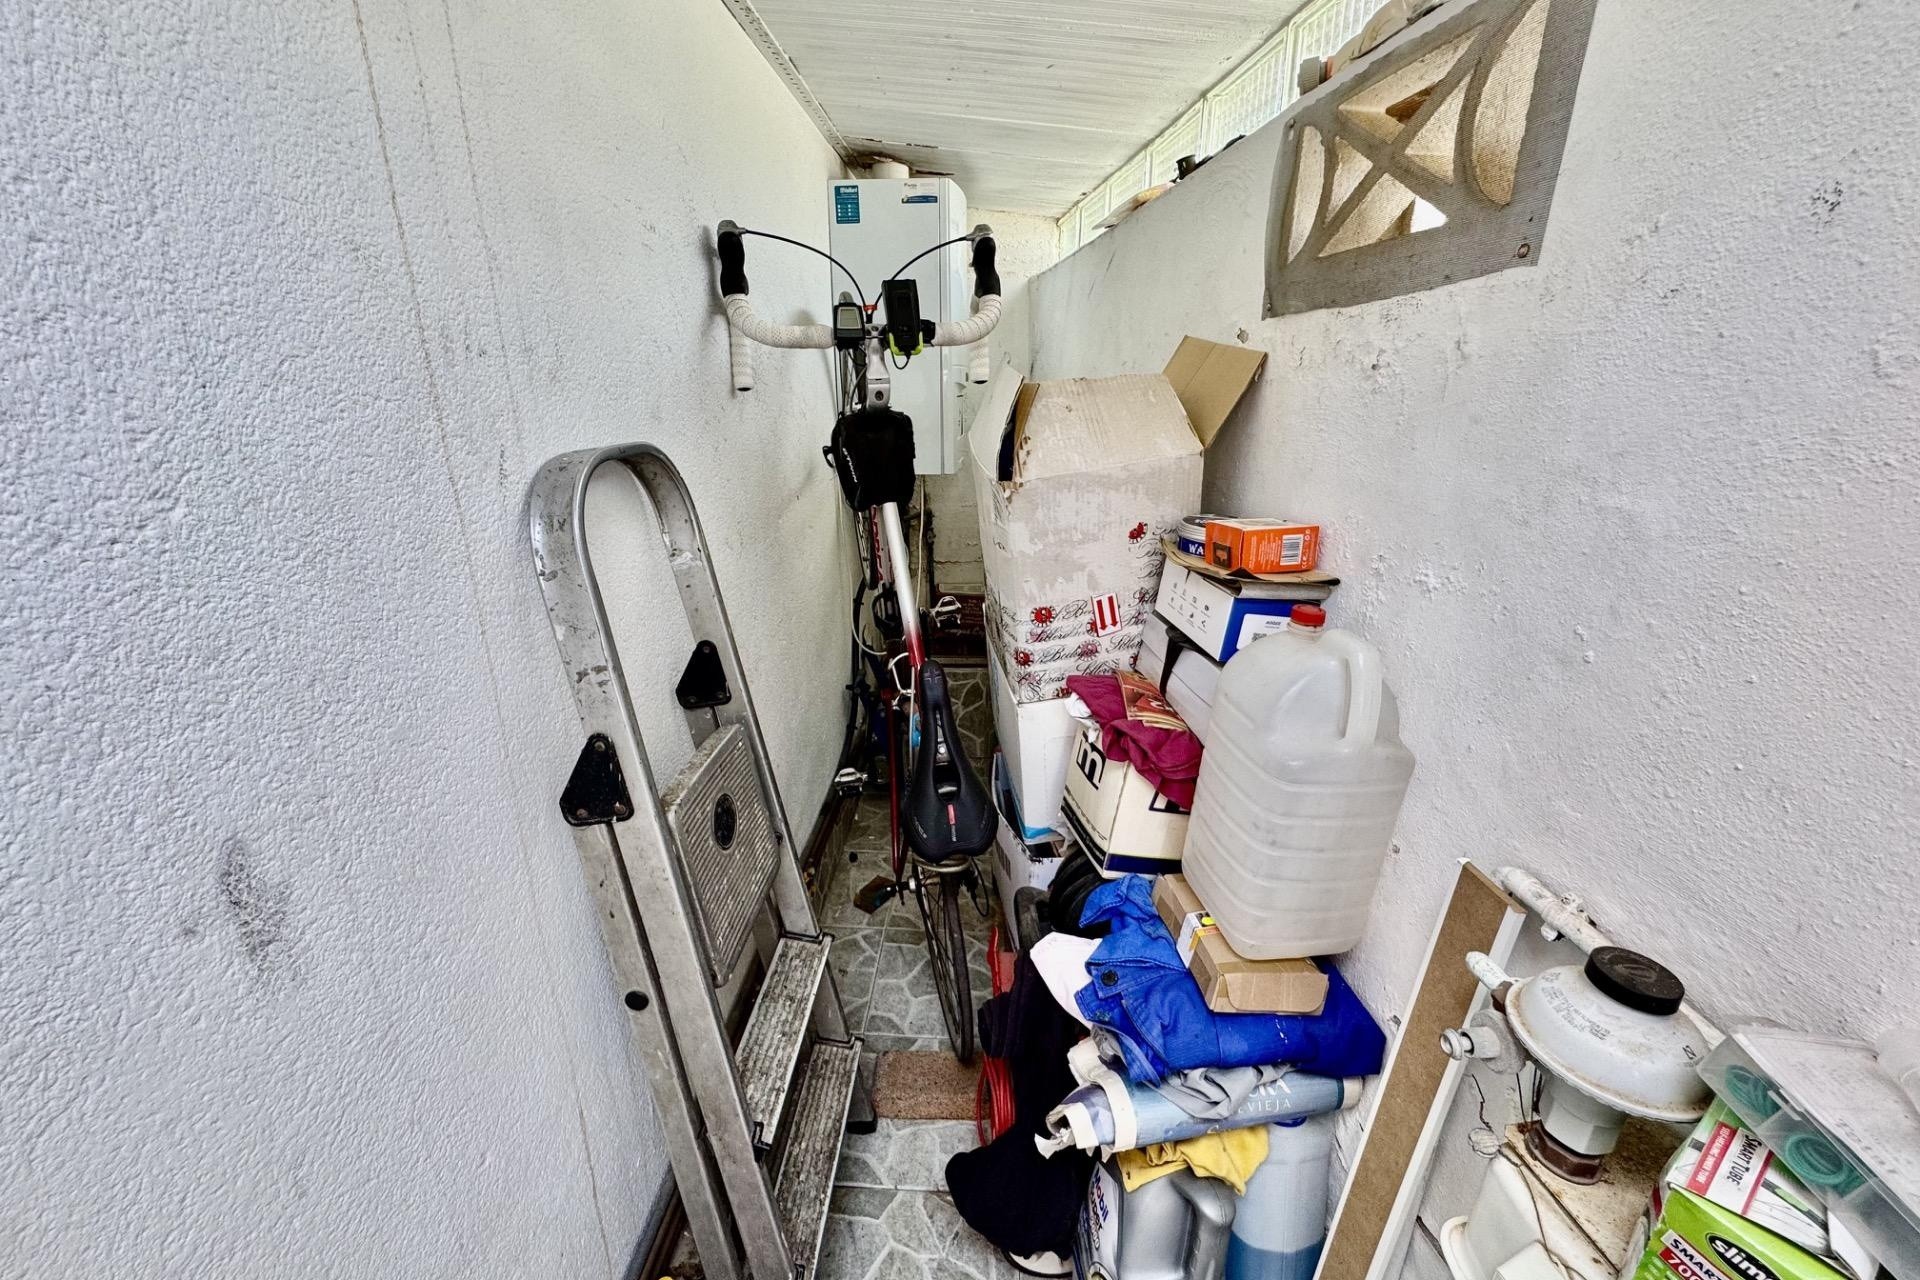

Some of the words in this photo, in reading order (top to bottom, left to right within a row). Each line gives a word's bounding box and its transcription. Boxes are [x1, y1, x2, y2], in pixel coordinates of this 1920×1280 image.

[1736, 1134, 1763, 1164] SMART
[1726, 1161, 1750, 1186] TUBE
[1094, 1166, 1109, 1223] Mobil
[1712, 1239, 1774, 1280] slim
